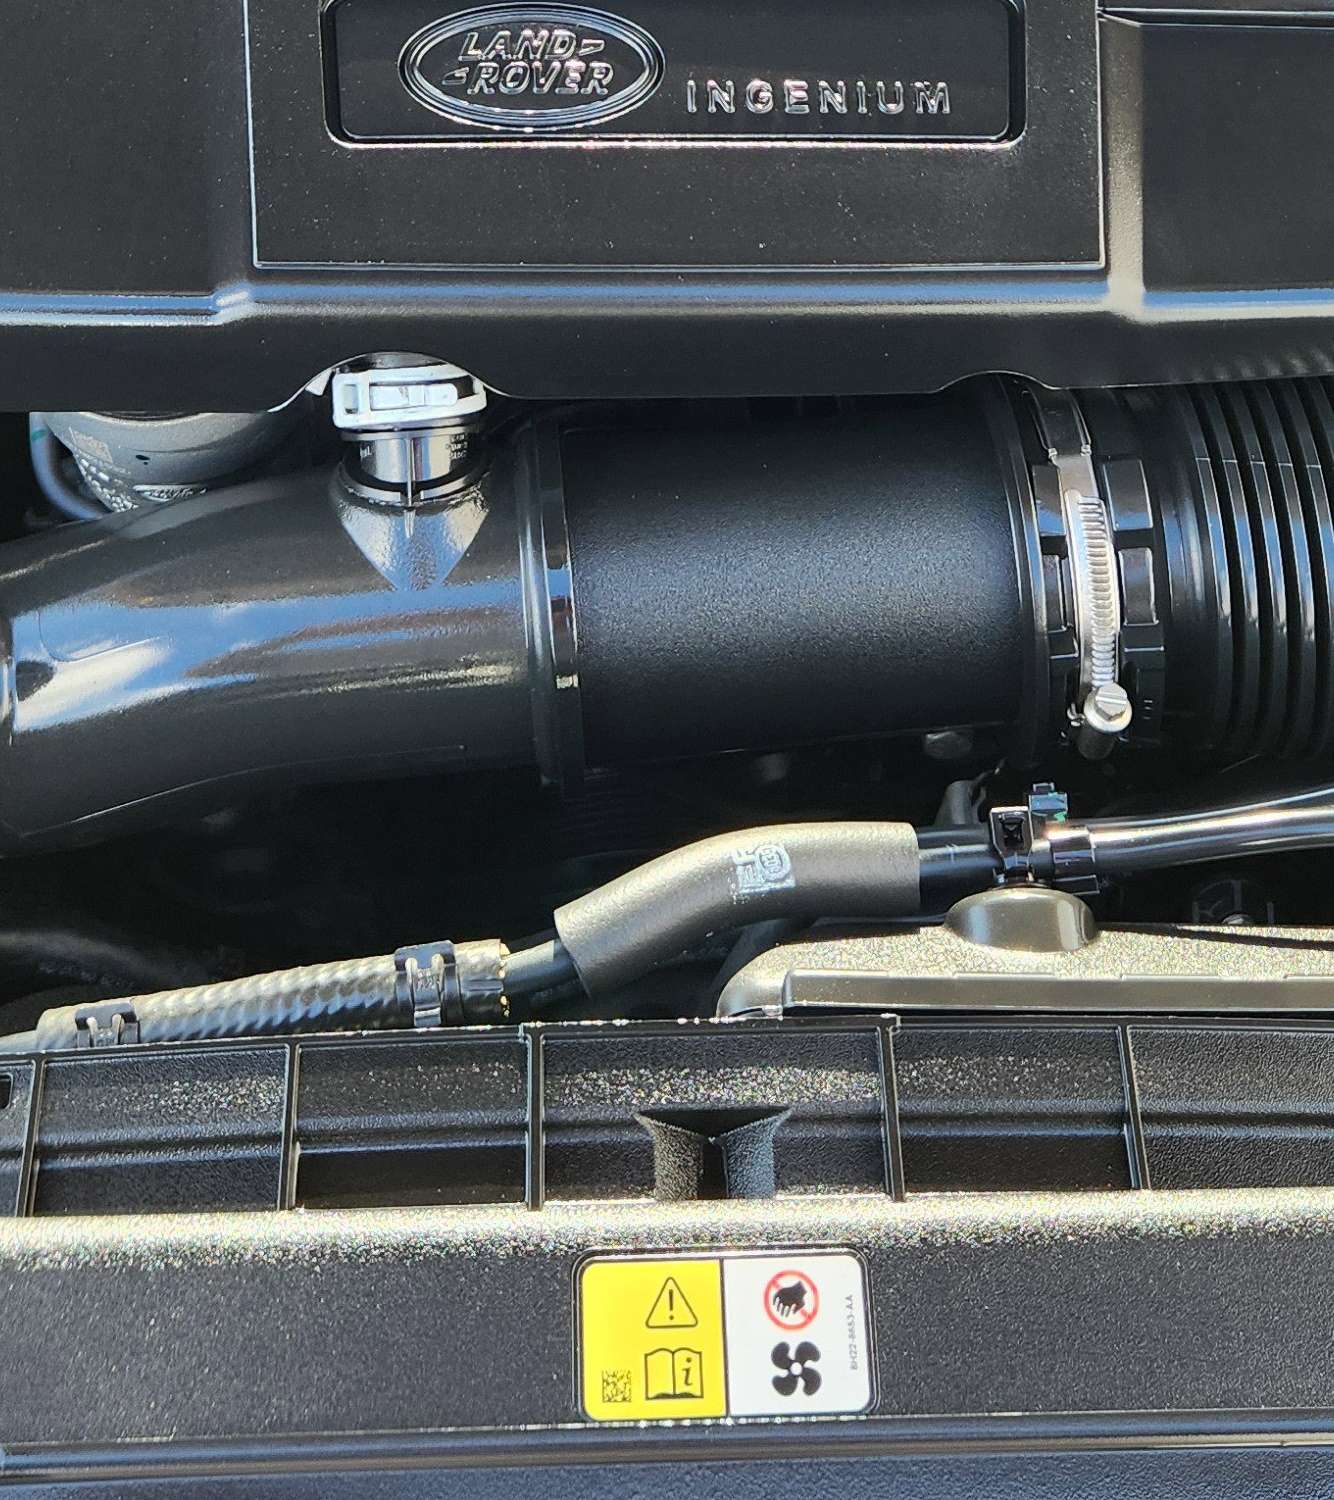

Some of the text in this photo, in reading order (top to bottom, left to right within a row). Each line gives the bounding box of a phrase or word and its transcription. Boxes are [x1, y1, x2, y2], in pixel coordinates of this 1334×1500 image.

[457, 29, 577, 62] LAND
[466, 60, 615, 95] ROVER
[685, 79, 952, 115] INGENIUM
